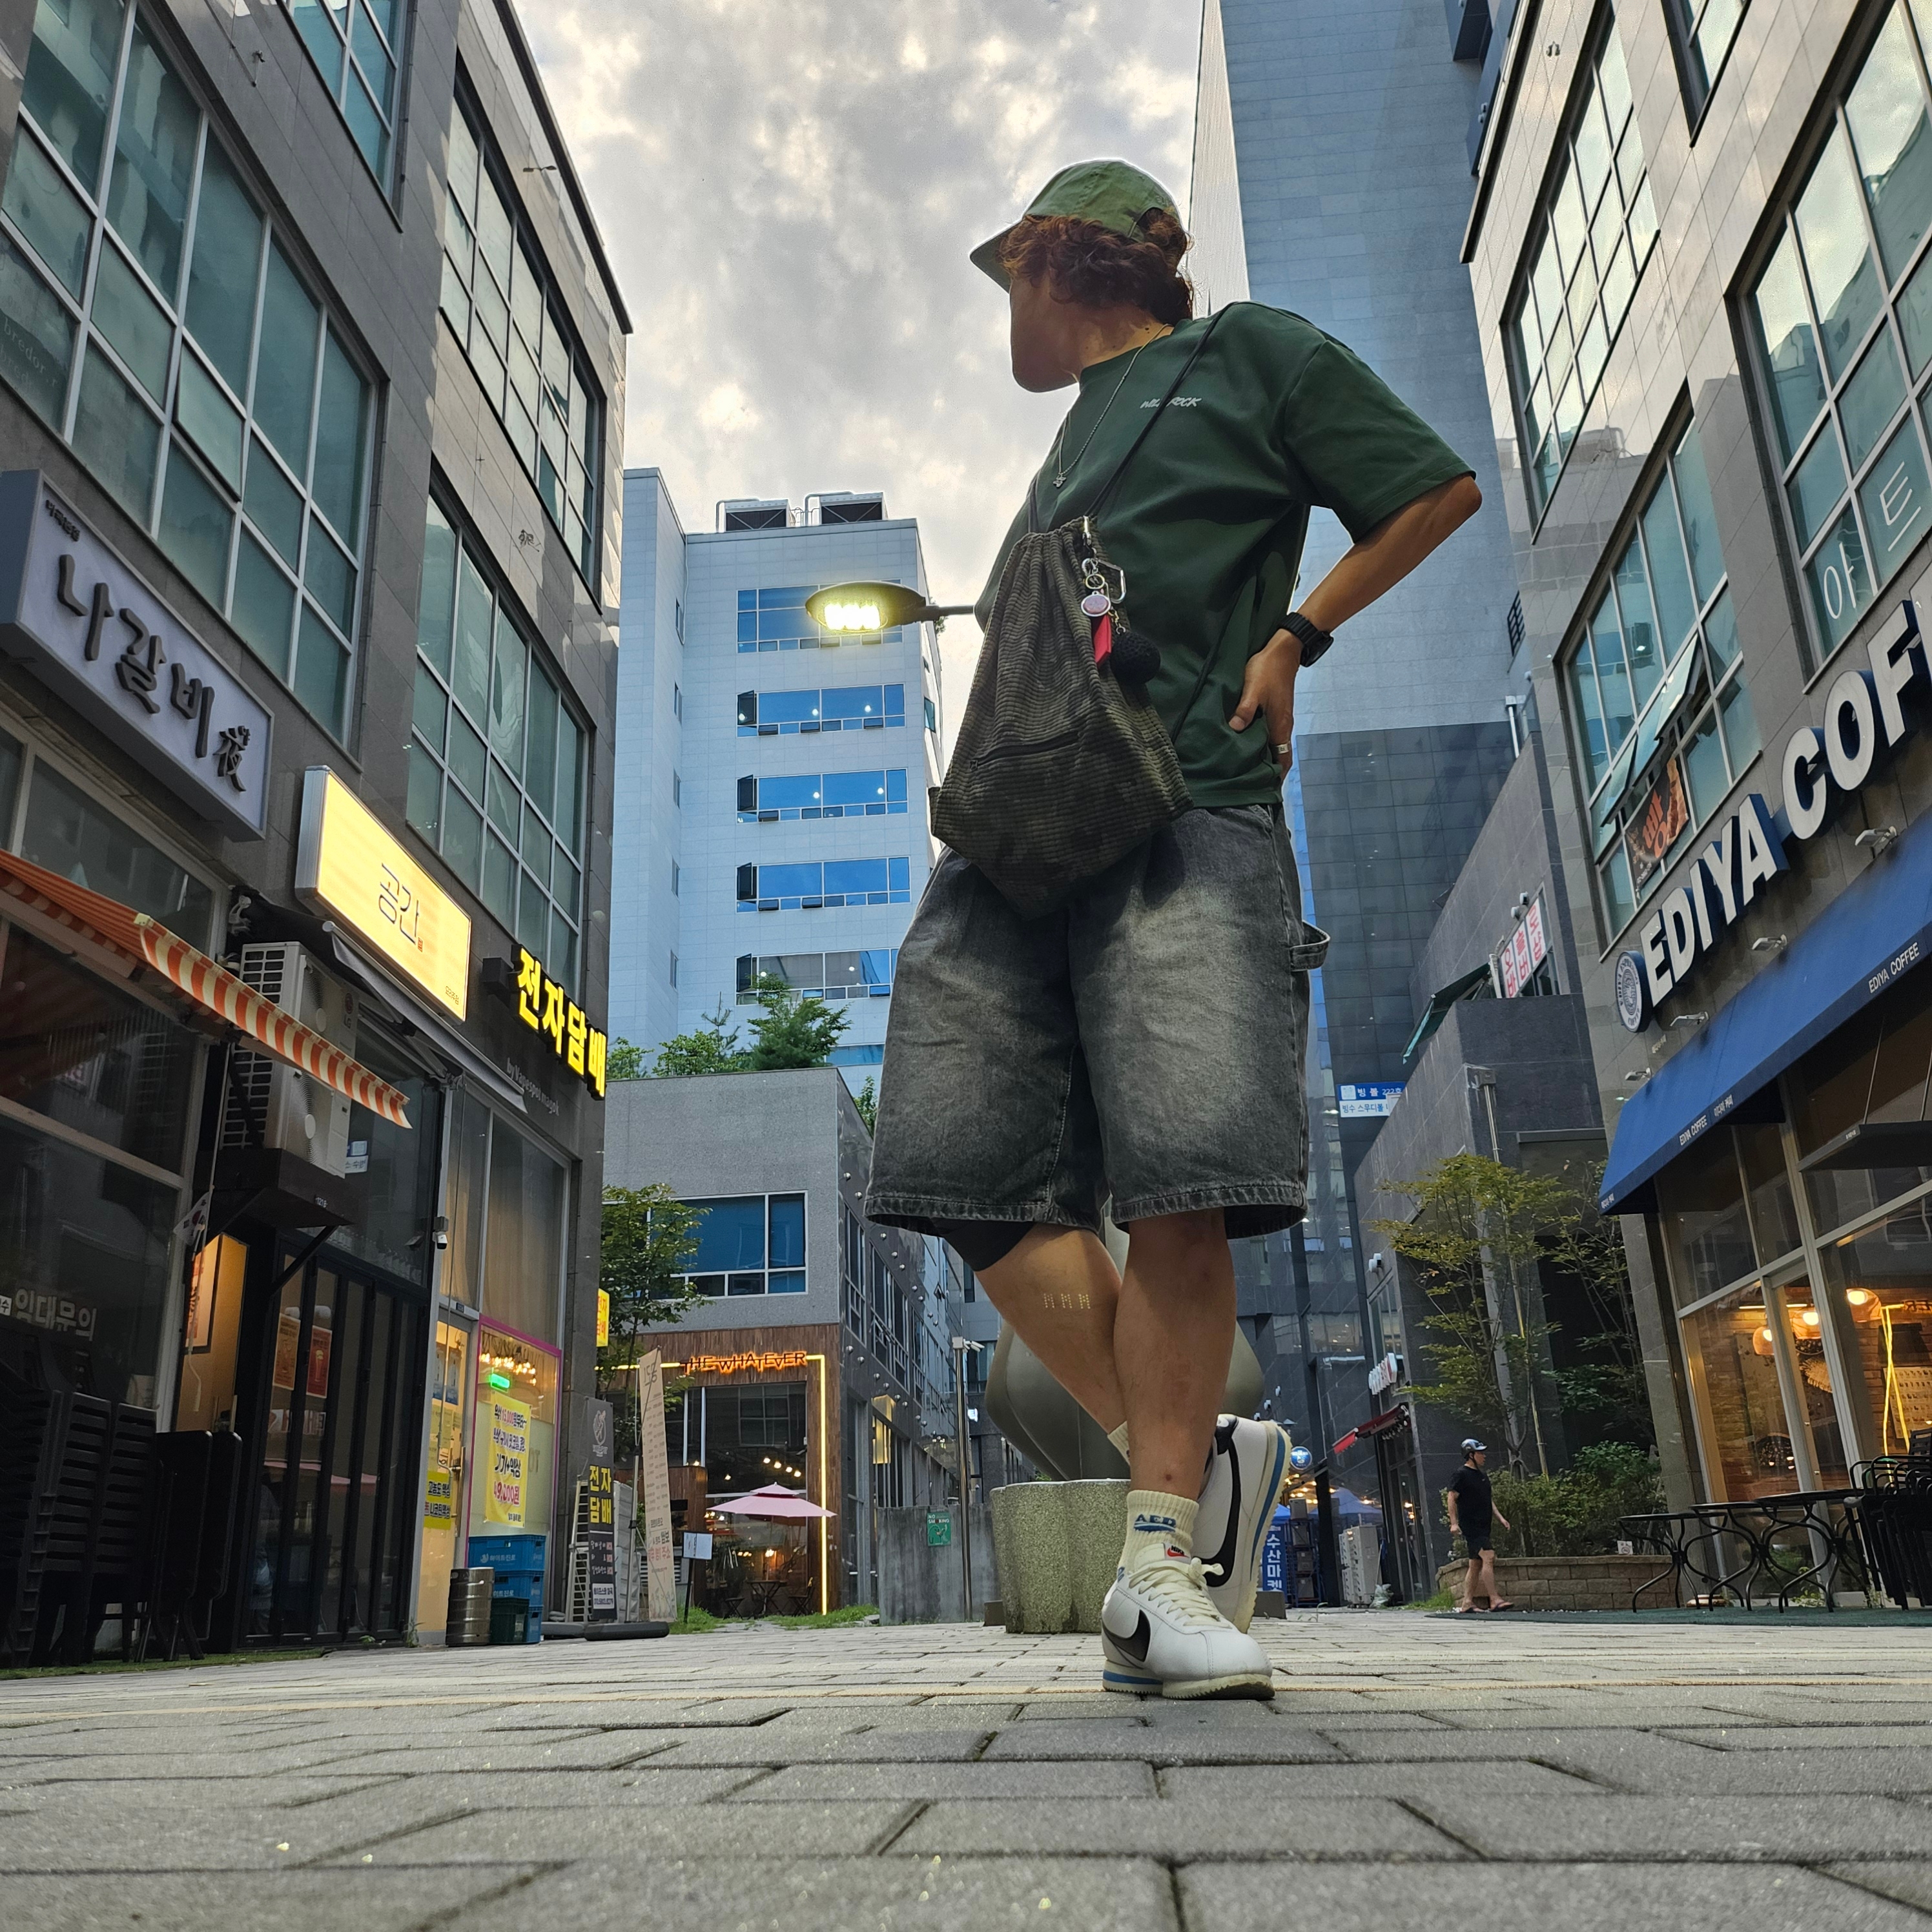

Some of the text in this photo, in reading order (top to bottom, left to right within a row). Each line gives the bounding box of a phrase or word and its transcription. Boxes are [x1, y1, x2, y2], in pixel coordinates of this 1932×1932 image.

[1140, 396, 1202, 409] WIL ROCK
[57, 554, 215, 758] 나갈비
[378, 863, 419, 945] 공간
[1640, 794, 1778, 1008] EDIYA
[1869, 941, 1920, 993] EDIYA COFFEE
[518, 947, 606, 1098] 전자담배
[1342, 1104, 1355, 1113] 빙수
[1357, 1103, 1384, 1113] 스무디볼
[1680, 1115, 1707, 1146] EDIYA COFFEE
[15, 1289, 97, 1341] 임대문의
[679, 1352, 806, 1375] THE WHATEVER
[590, 1465, 611, 1494] 전자
[590, 1496, 611, 1525] 담배
[1267, 1534, 1282, 1590] 수산마켓
[493, 1590, 514, 1599] 이트진로
